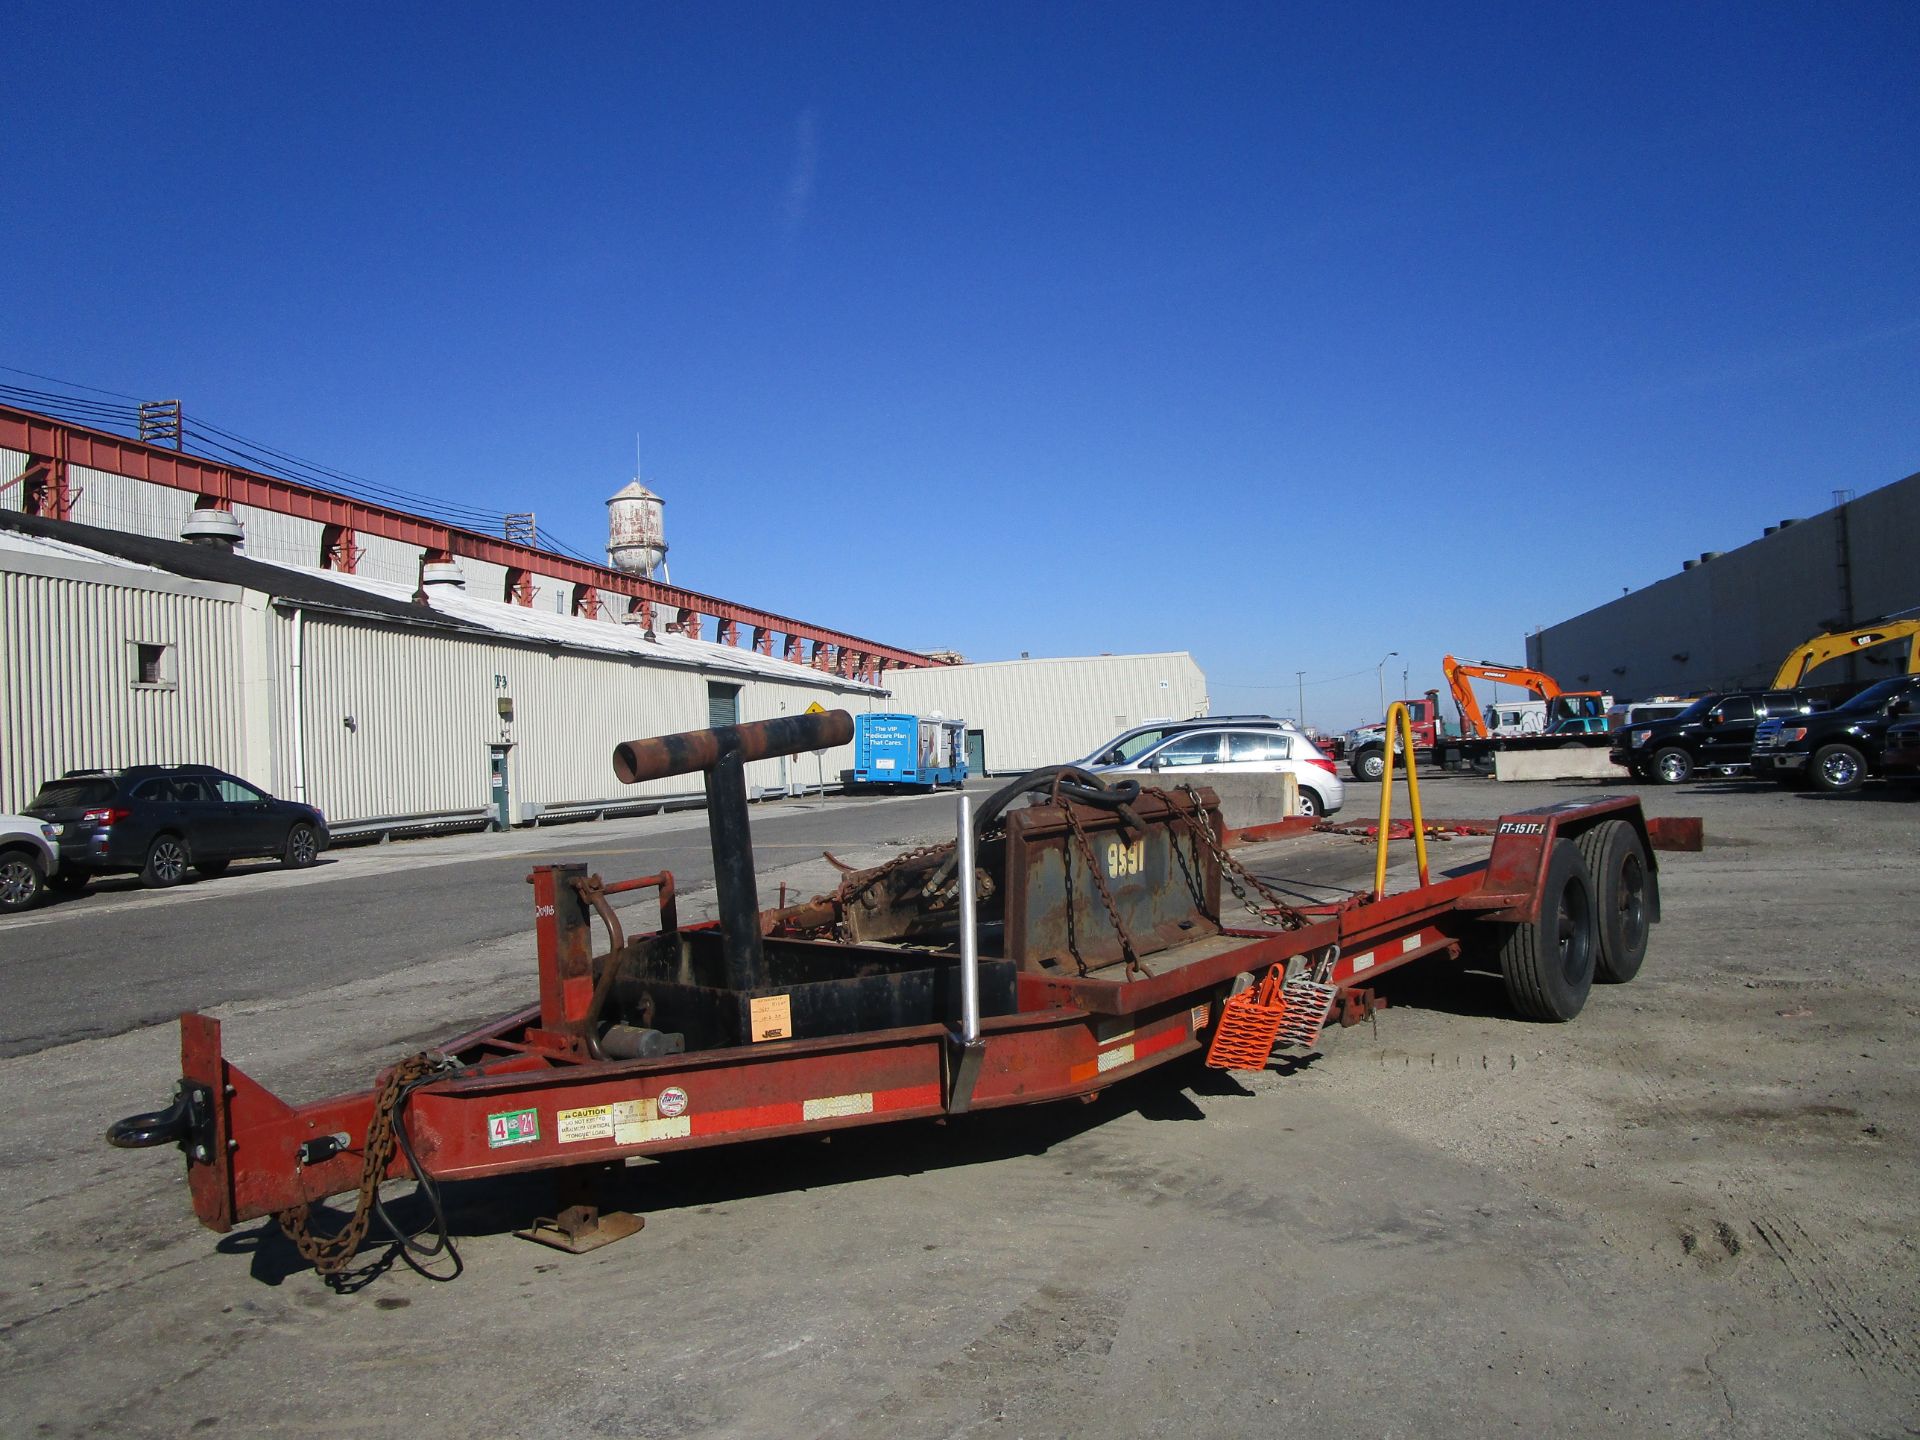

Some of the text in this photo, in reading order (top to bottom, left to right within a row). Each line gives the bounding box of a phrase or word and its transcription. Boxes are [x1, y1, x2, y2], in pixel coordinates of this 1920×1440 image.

[572, 1108, 606, 1118] CAUTION
[495, 1113, 534, 1138] 4 21
[587, 1122, 610, 1130] VERTICAL
